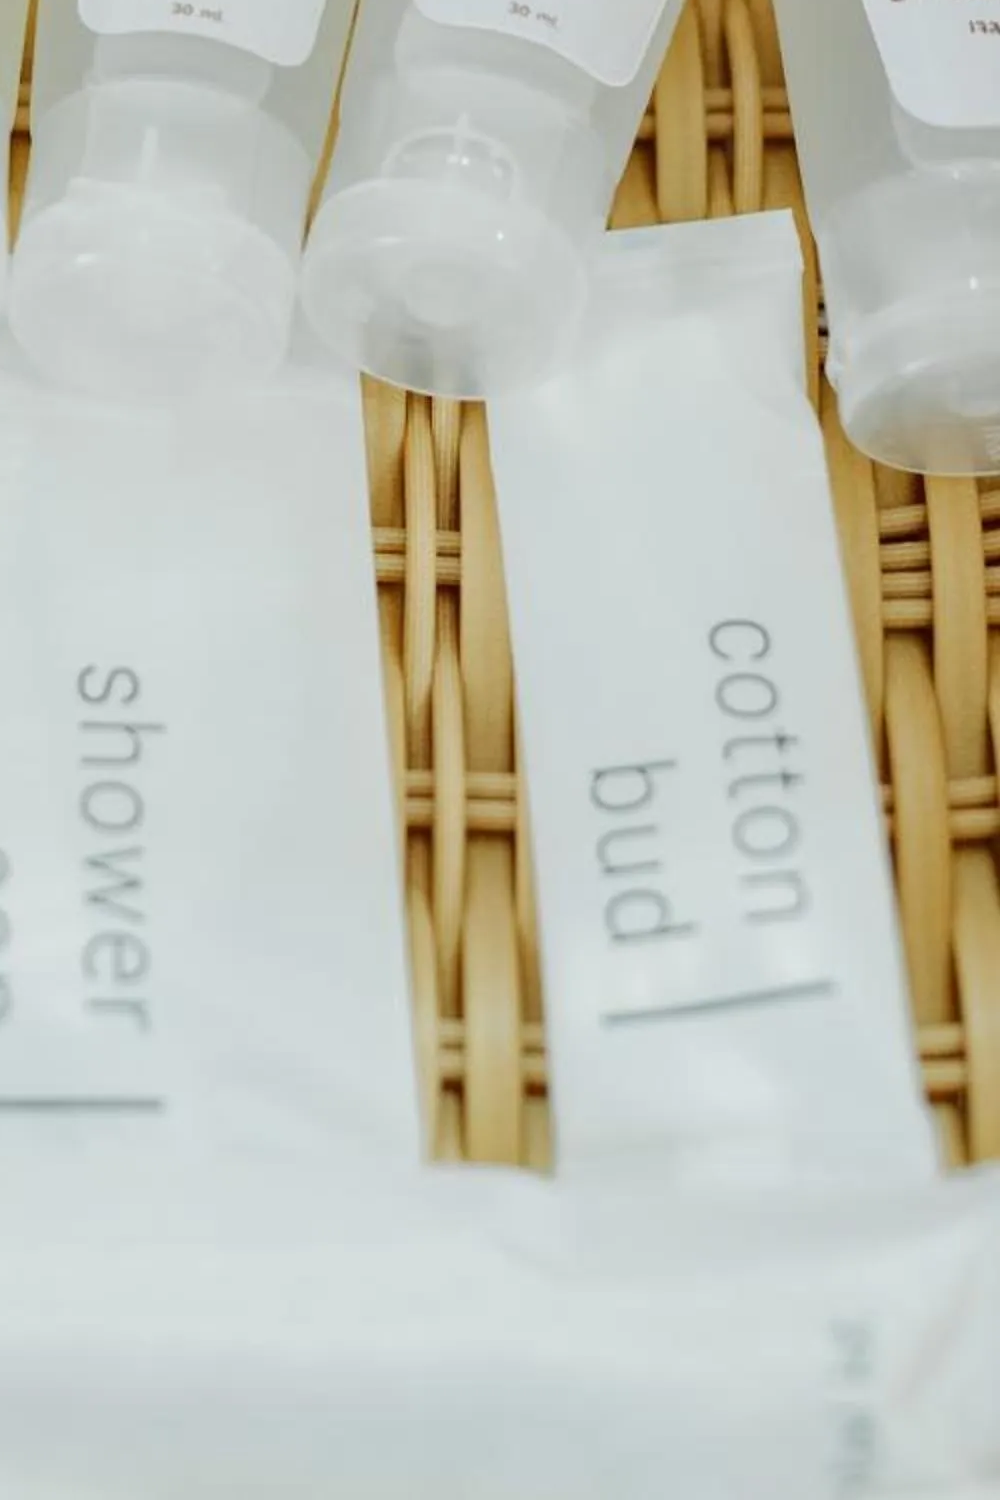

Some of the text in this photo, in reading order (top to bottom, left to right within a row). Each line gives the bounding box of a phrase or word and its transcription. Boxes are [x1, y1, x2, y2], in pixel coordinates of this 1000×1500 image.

[172, 2, 195, 17] 30
[507, 0, 532, 18] 30
[76, 664, 167, 1032] shower
[589, 759, 698, 947] bud
[707, 618, 809, 925] cotton
